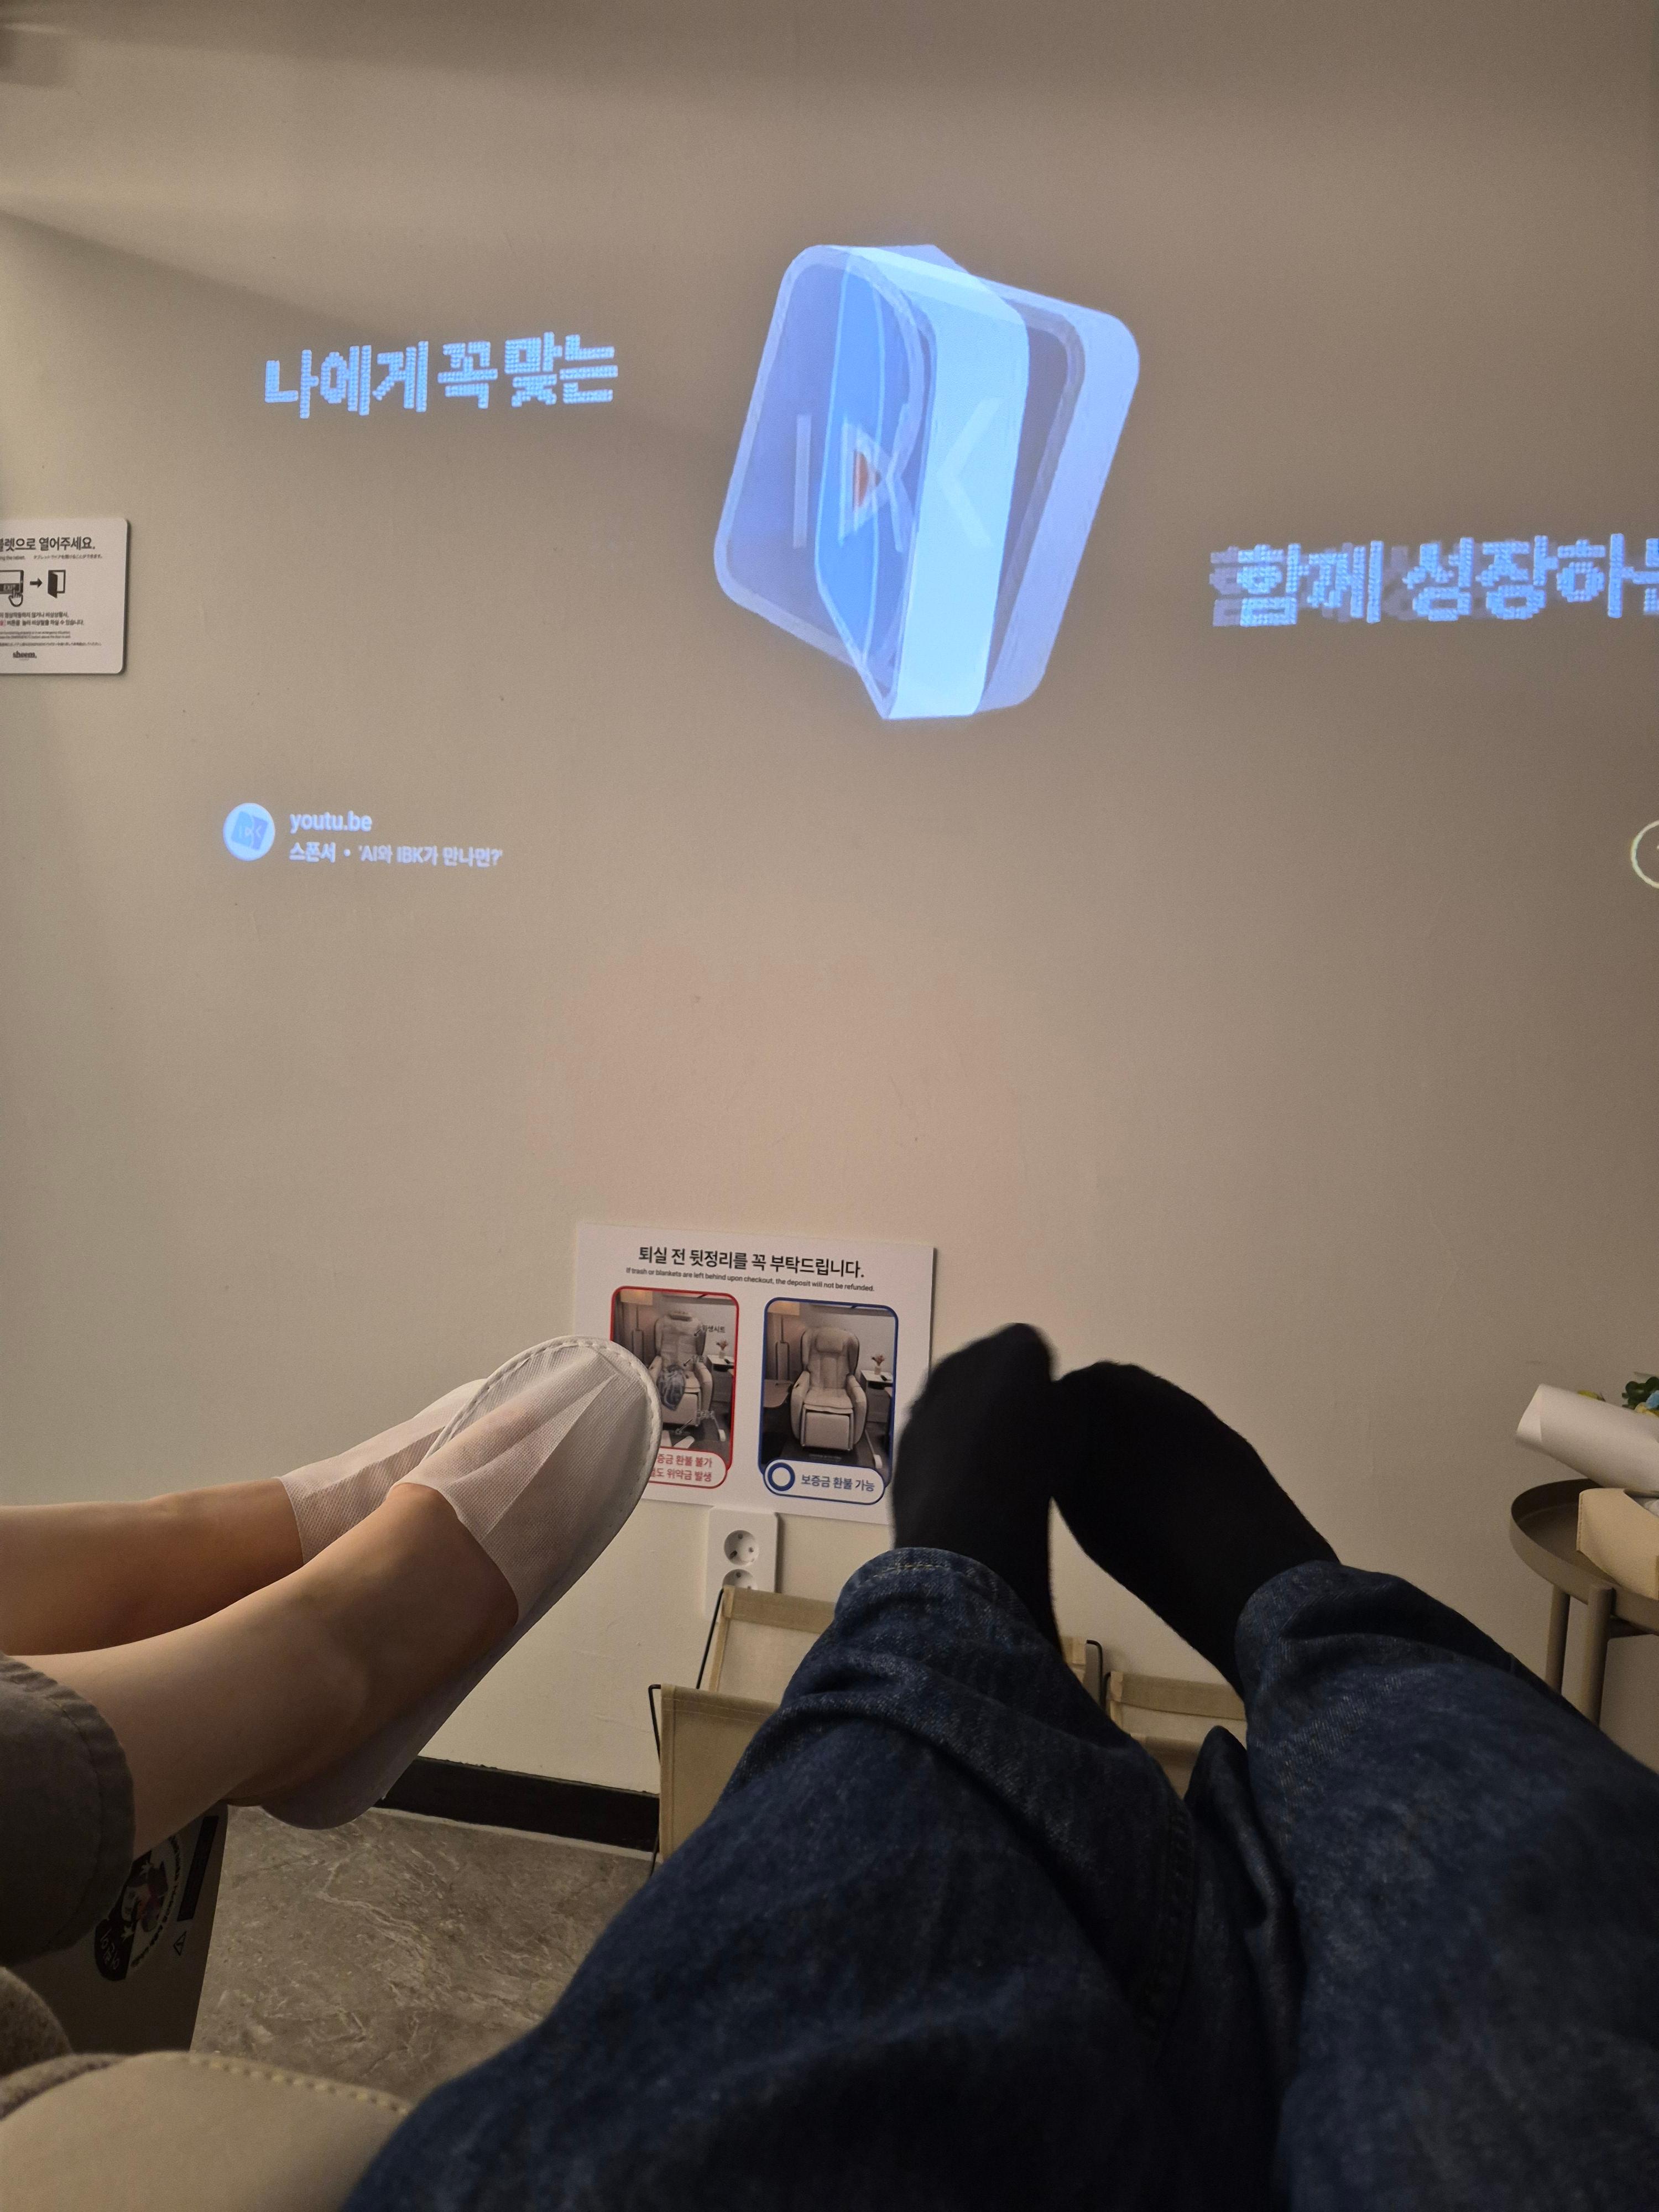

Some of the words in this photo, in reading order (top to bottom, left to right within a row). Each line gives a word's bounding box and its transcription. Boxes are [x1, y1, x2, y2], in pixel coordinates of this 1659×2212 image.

[264, 341, 429, 419] 나에게
[437, 341, 498, 409] 꼭
[504, 331, 618, 408] 맞는
[0, 538, 36, 551] 렛으로
[39, 536, 96, 551] 열어주세요.
[1237, 540, 1384, 627] 함께
[290, 811, 372, 834] youtu.be
[289, 842, 336, 862] 스폰서
[397, 846, 438, 866] IBK가
[639, 1246, 667, 1264] 퇴실
[671, 1248, 686, 1265] 전
[689, 1249, 748, 1270] 뒷정리를
[752, 1254, 766, 1271] 꼭
[770, 1255, 864, 1278] 부탁드립니다.
[844, 1284, 875, 1292] refunded.
[657, 1453, 674, 1464] 증금
[676, 1455, 692, 1466] 환불
[695, 1456, 712, 1468] 불가
[667, 1468, 692, 1480] 위약금
[695, 1471, 712, 1482] 발생
[801, 1474, 830, 1488] 보증금
[833, 1477, 853, 1490] 환불
[855, 1479, 875, 1492] 가능
